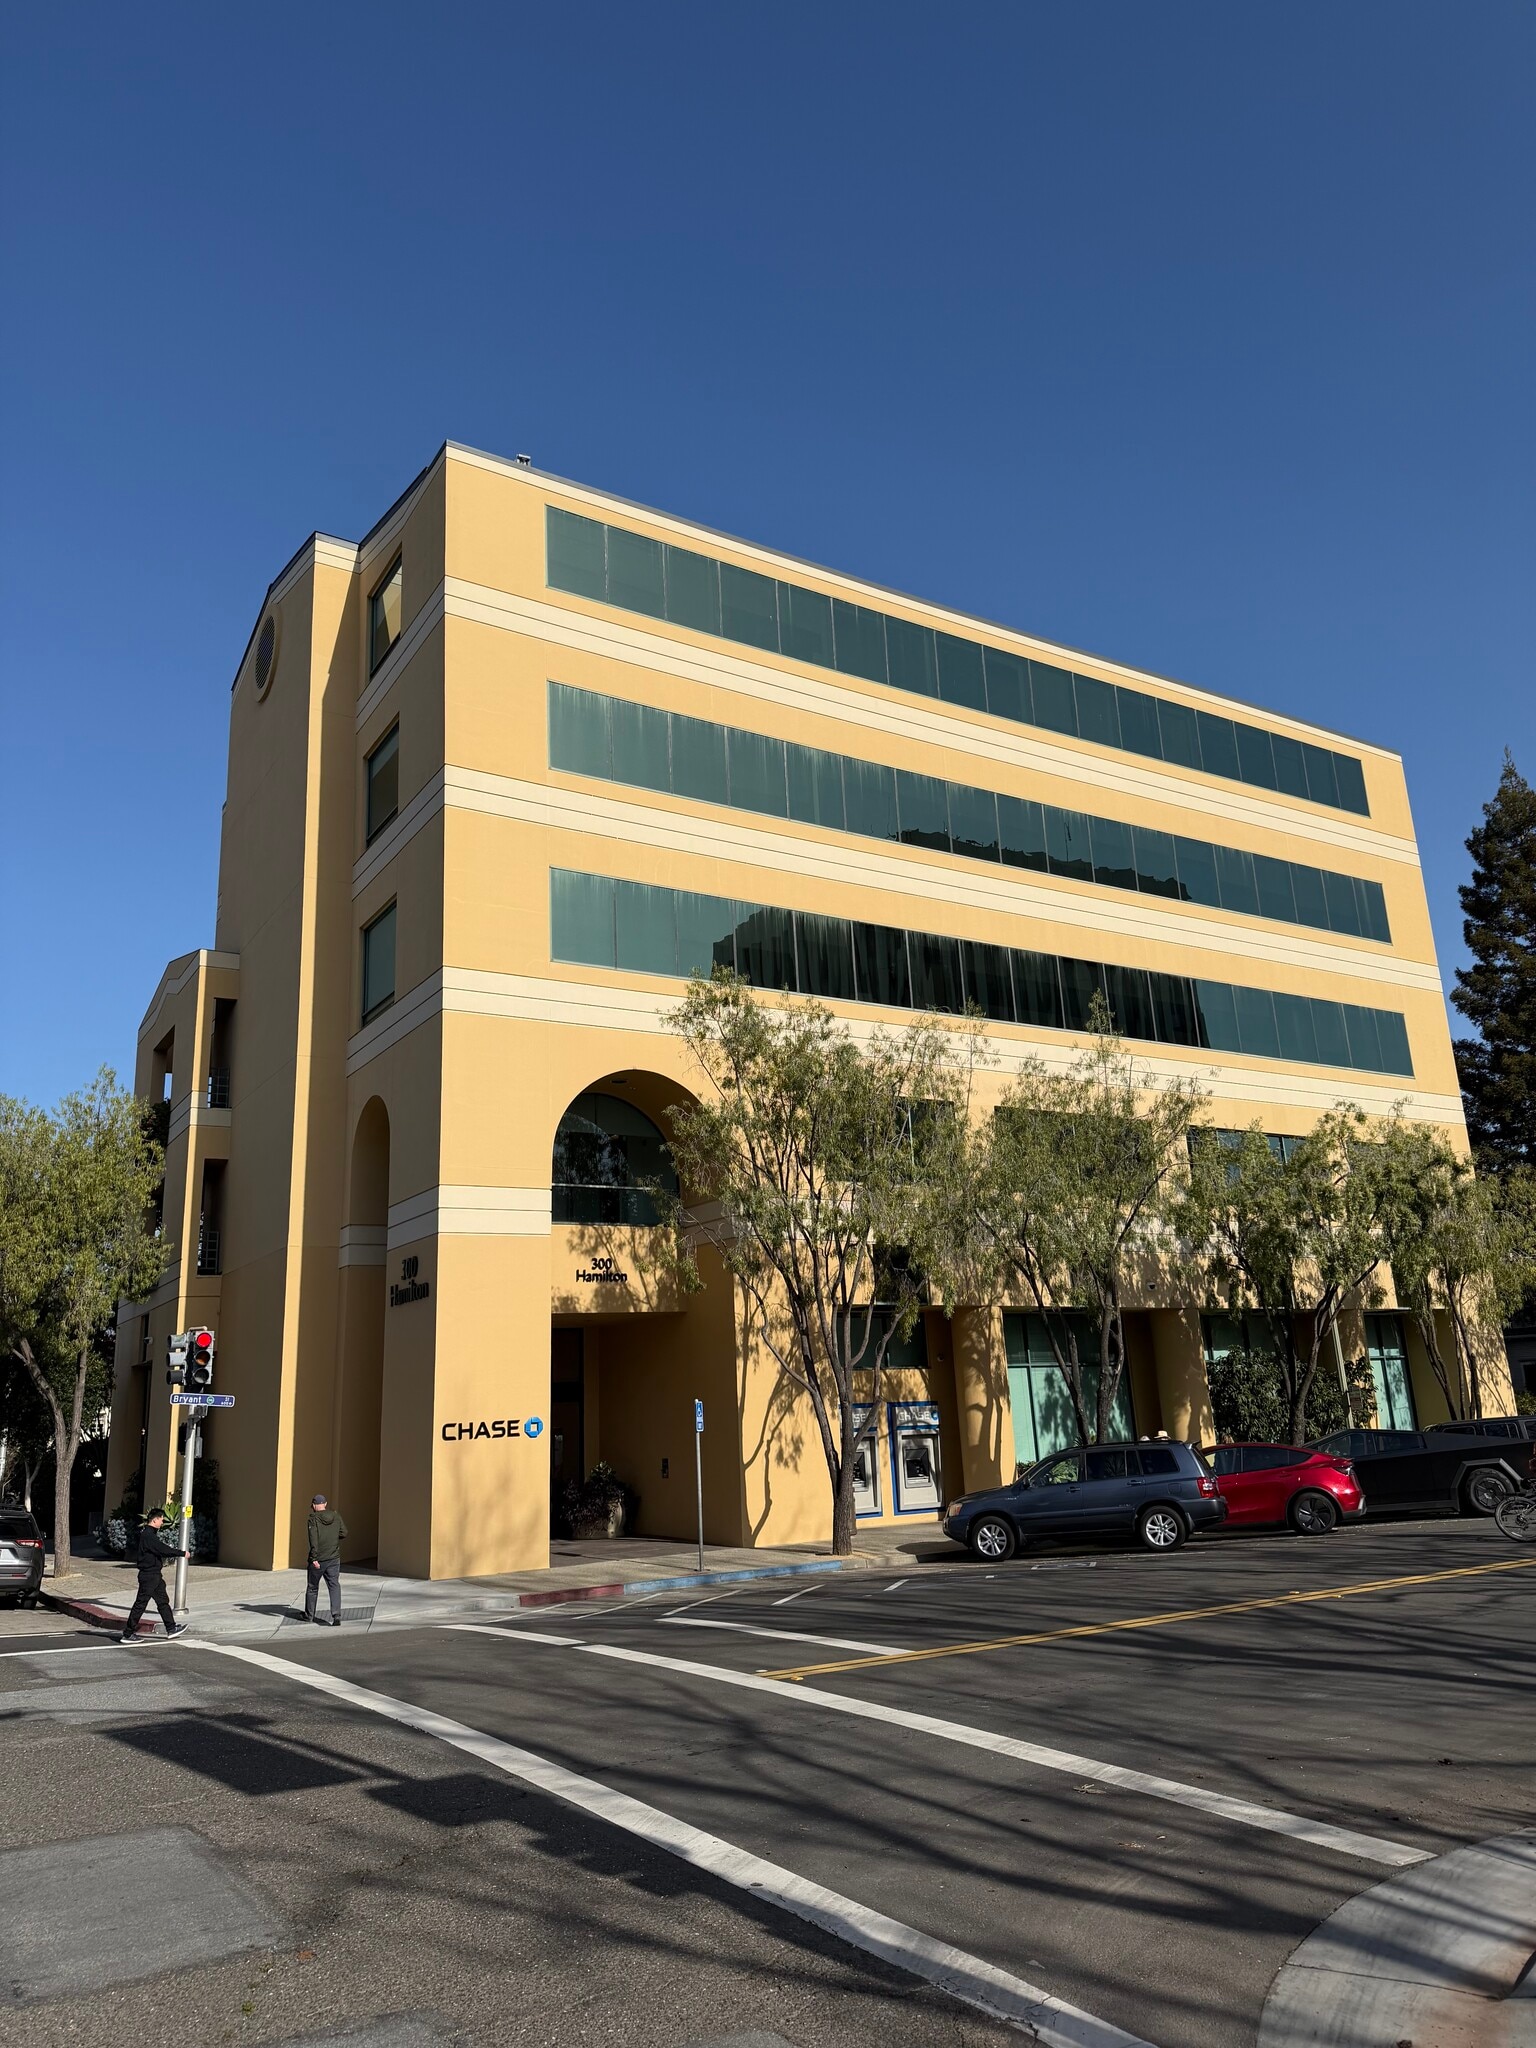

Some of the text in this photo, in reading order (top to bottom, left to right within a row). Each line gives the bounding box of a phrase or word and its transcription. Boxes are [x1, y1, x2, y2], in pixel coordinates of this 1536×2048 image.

[401, 1255, 419, 1281] 300
[591, 1257, 613, 1271] 300
[576, 1269, 628, 1283] Hamilton
[390, 1278, 430, 1307] Hamilton
[173, 1395, 202, 1404] Bryant
[898, 1411, 931, 1421] CHASE
[442, 1419, 521, 1441] CHASE
